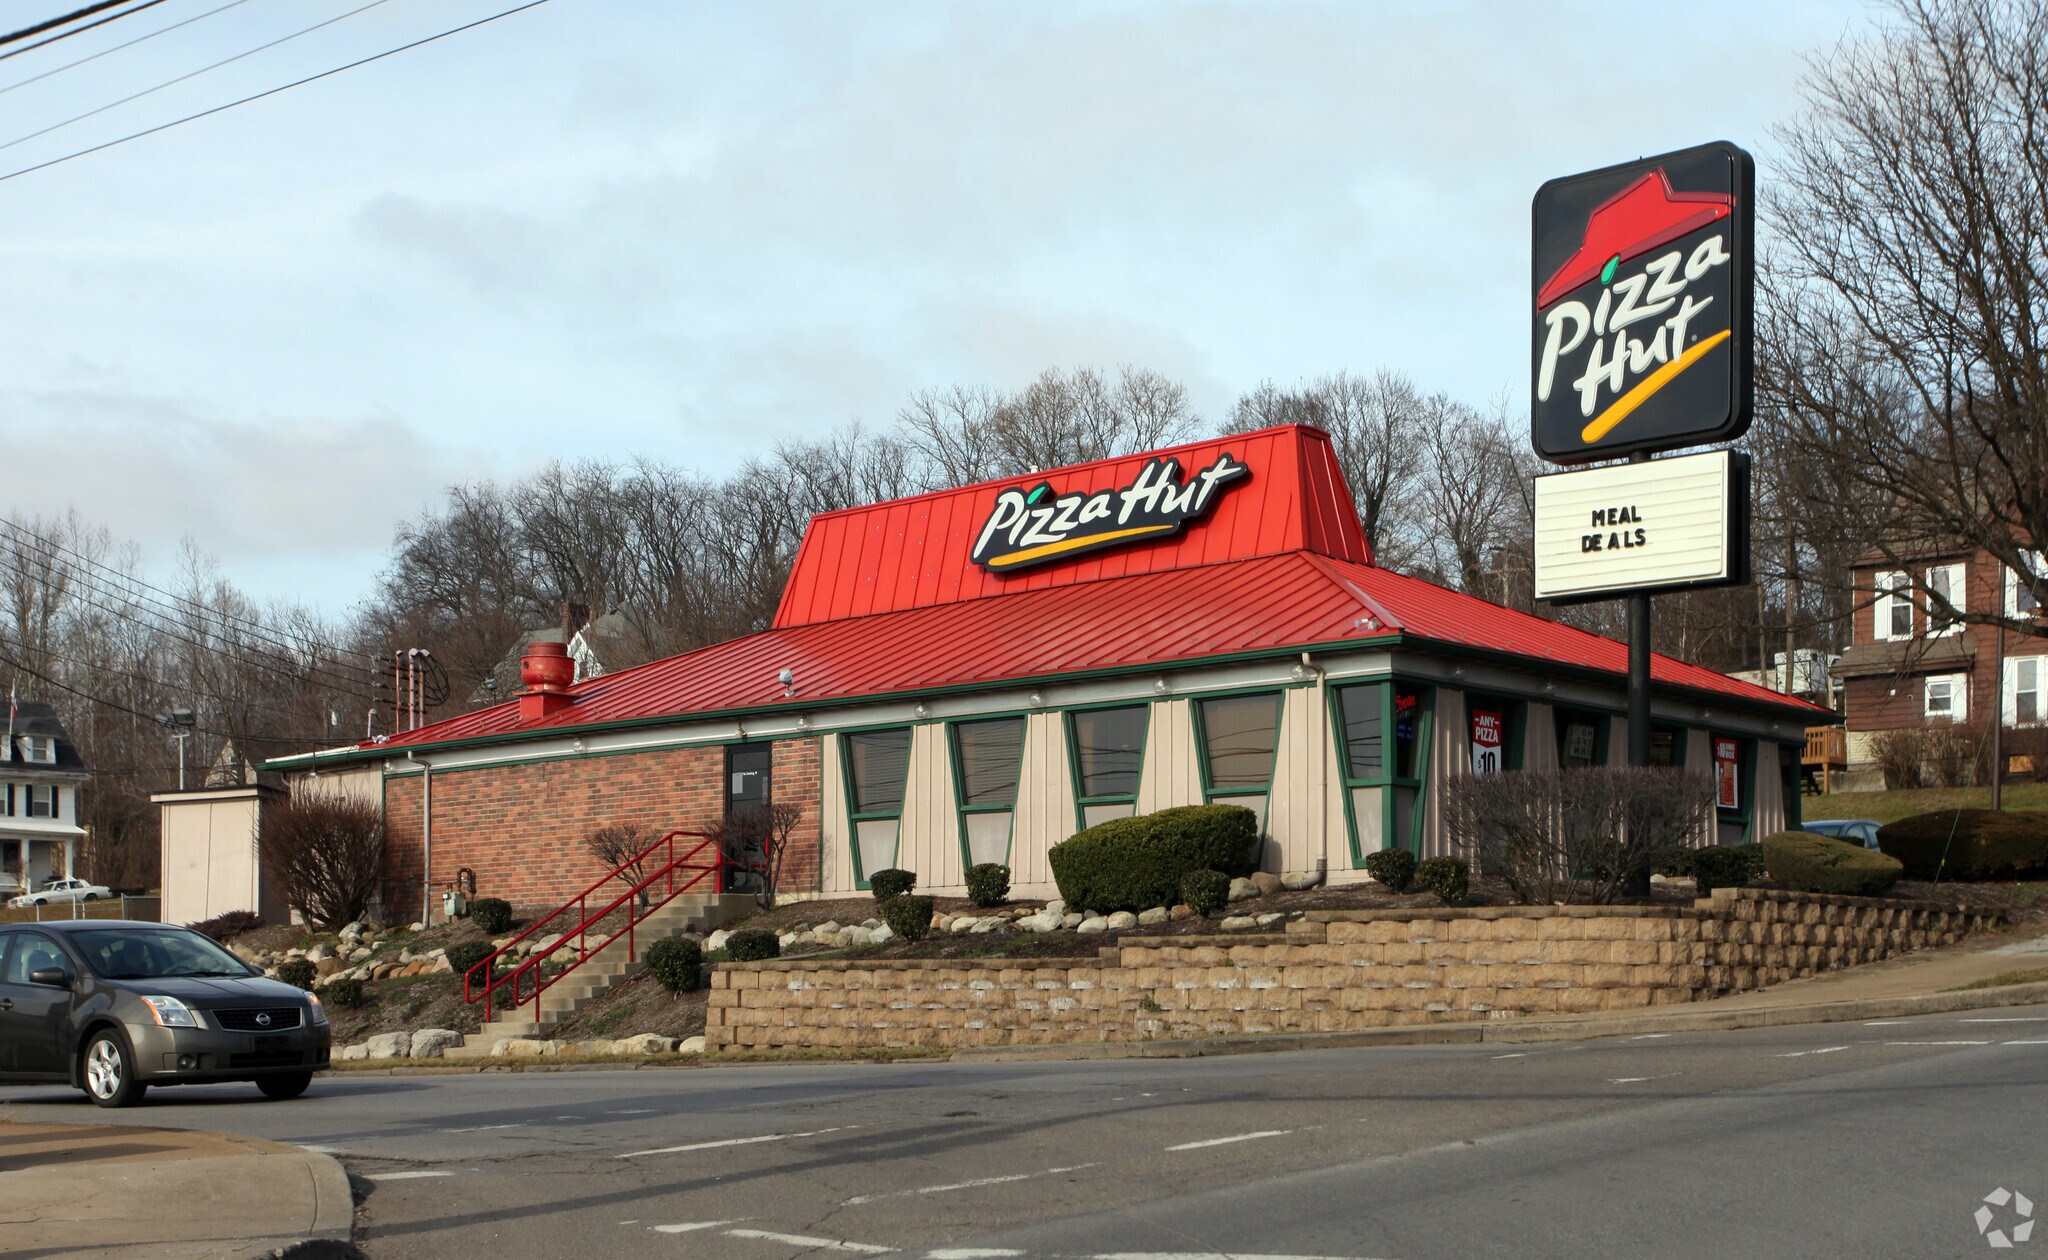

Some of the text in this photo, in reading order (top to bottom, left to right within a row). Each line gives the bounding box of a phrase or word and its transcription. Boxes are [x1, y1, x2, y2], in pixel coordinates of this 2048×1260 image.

[1537, 234, 1730, 402] Pizza
[1573, 295, 1714, 417] Hut
[973, 457, 1242, 559] Pizza Hut
[1592, 505, 1642, 528] MEAL
[1582, 528, 1646, 553] DEALS
[1475, 726, 1499, 743] PIZZA
[1478, 751, 1496, 775] $10
